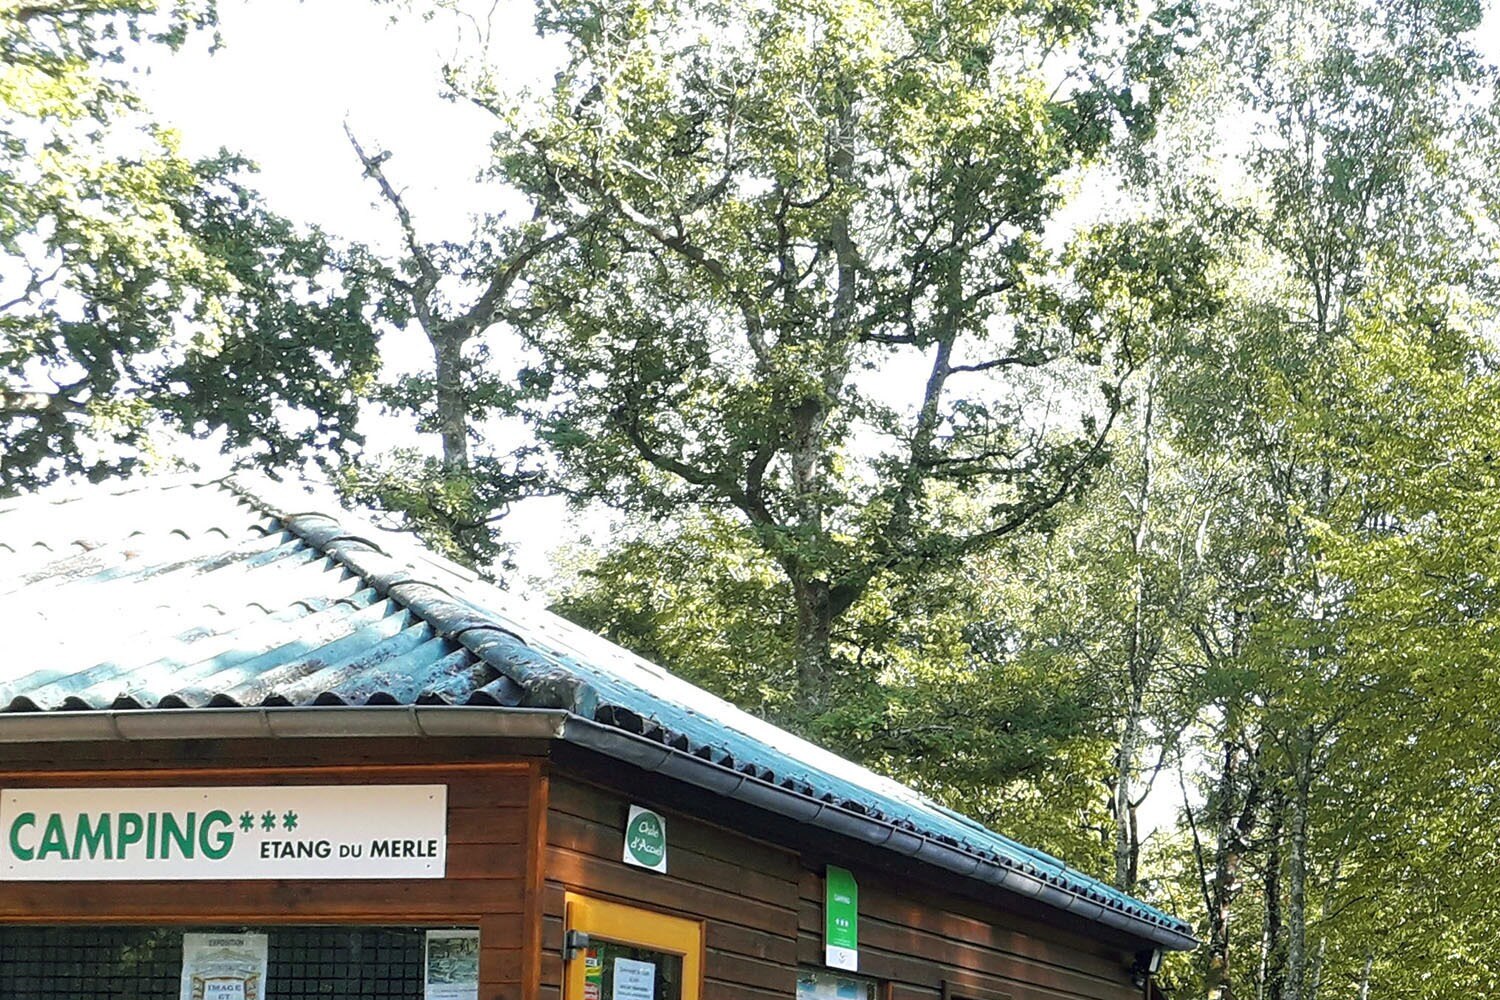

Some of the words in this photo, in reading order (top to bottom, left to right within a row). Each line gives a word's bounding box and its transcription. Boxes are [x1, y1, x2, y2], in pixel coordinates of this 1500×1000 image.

[9, 809, 236, 862] CAMPING
[259, 840, 332, 859] ETANG
[338, 844, 363, 859] DU
[369, 839, 438, 858] MERLE
[207, 984, 242, 992] IMAGE
[218, 993, 232, 1000] ET
